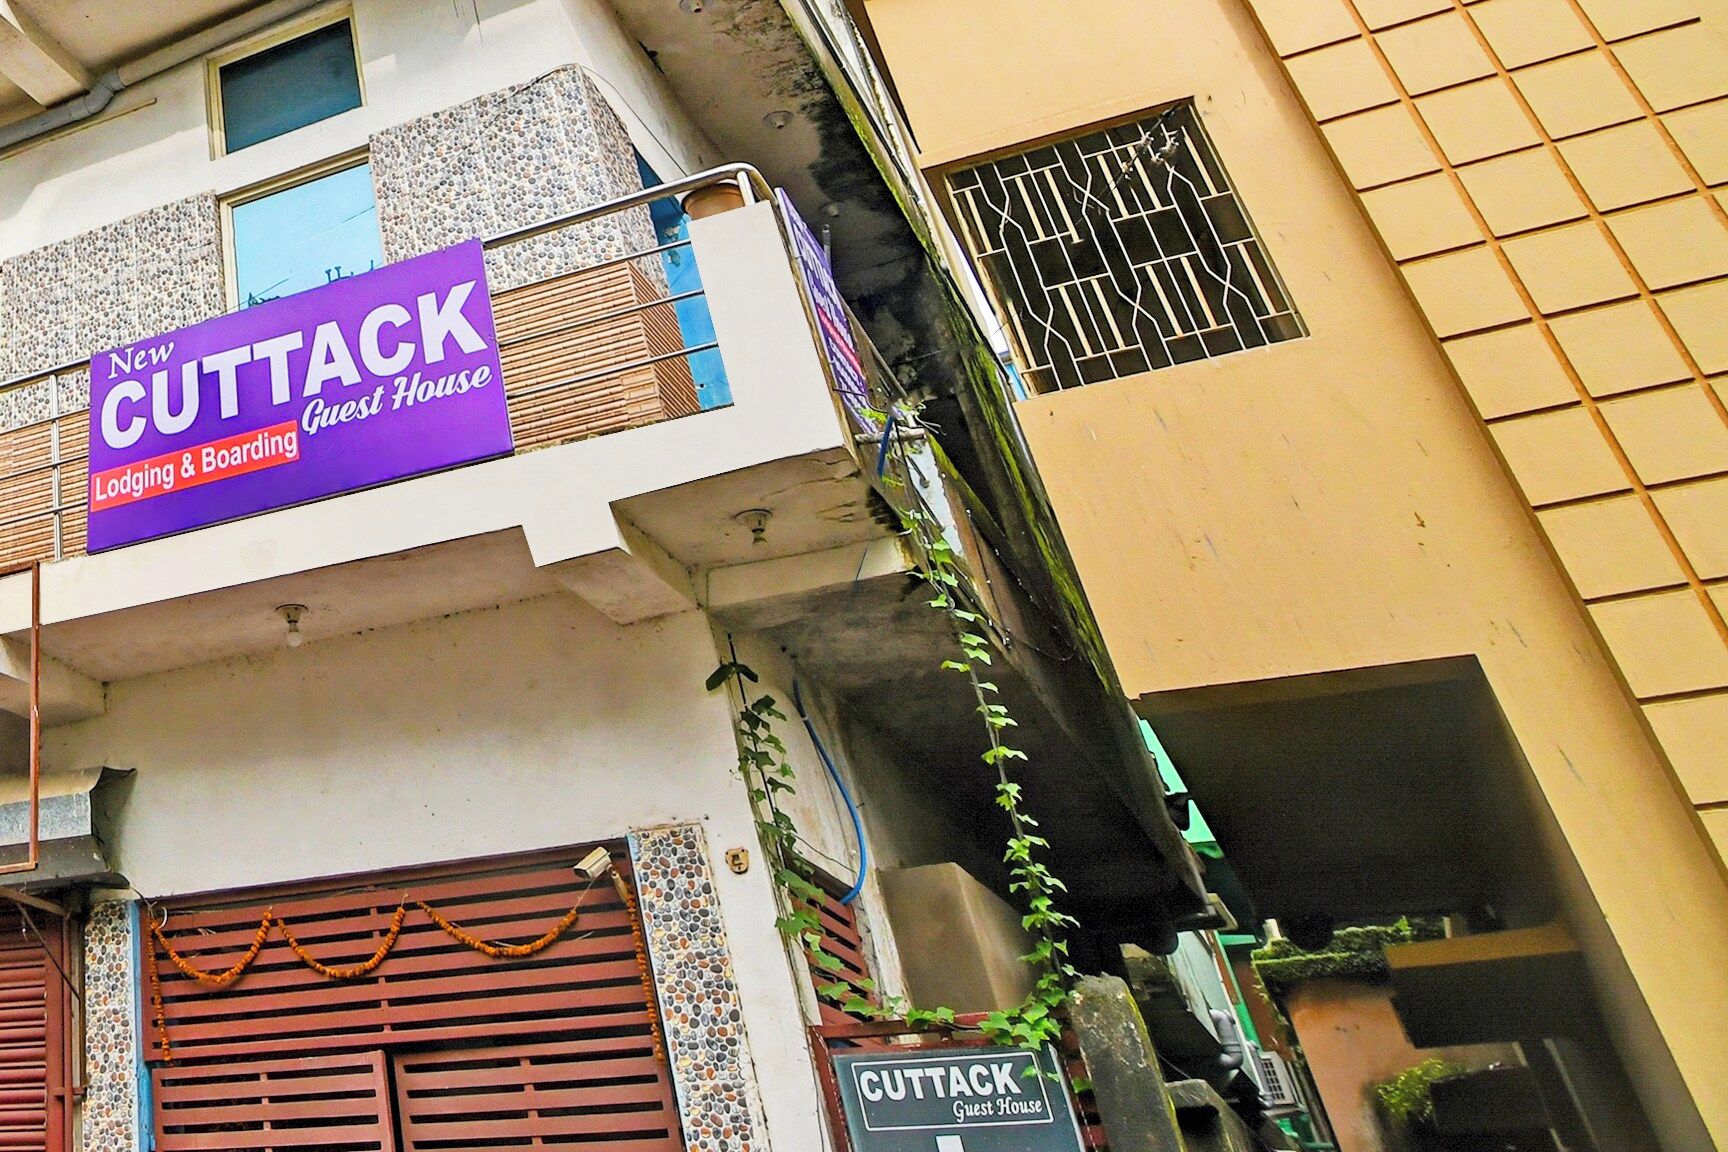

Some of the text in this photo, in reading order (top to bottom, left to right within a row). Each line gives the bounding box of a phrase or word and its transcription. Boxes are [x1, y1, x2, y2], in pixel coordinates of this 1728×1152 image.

[100, 280, 489, 450] CUTTACK
[106, 340, 175, 380] New
[301, 364, 493, 435] Guest House
[94, 430, 298, 502] Lodging & Boarding
[859, 1061, 1022, 1103] CUTTACK
[952, 1096, 1043, 1124] Guest House
